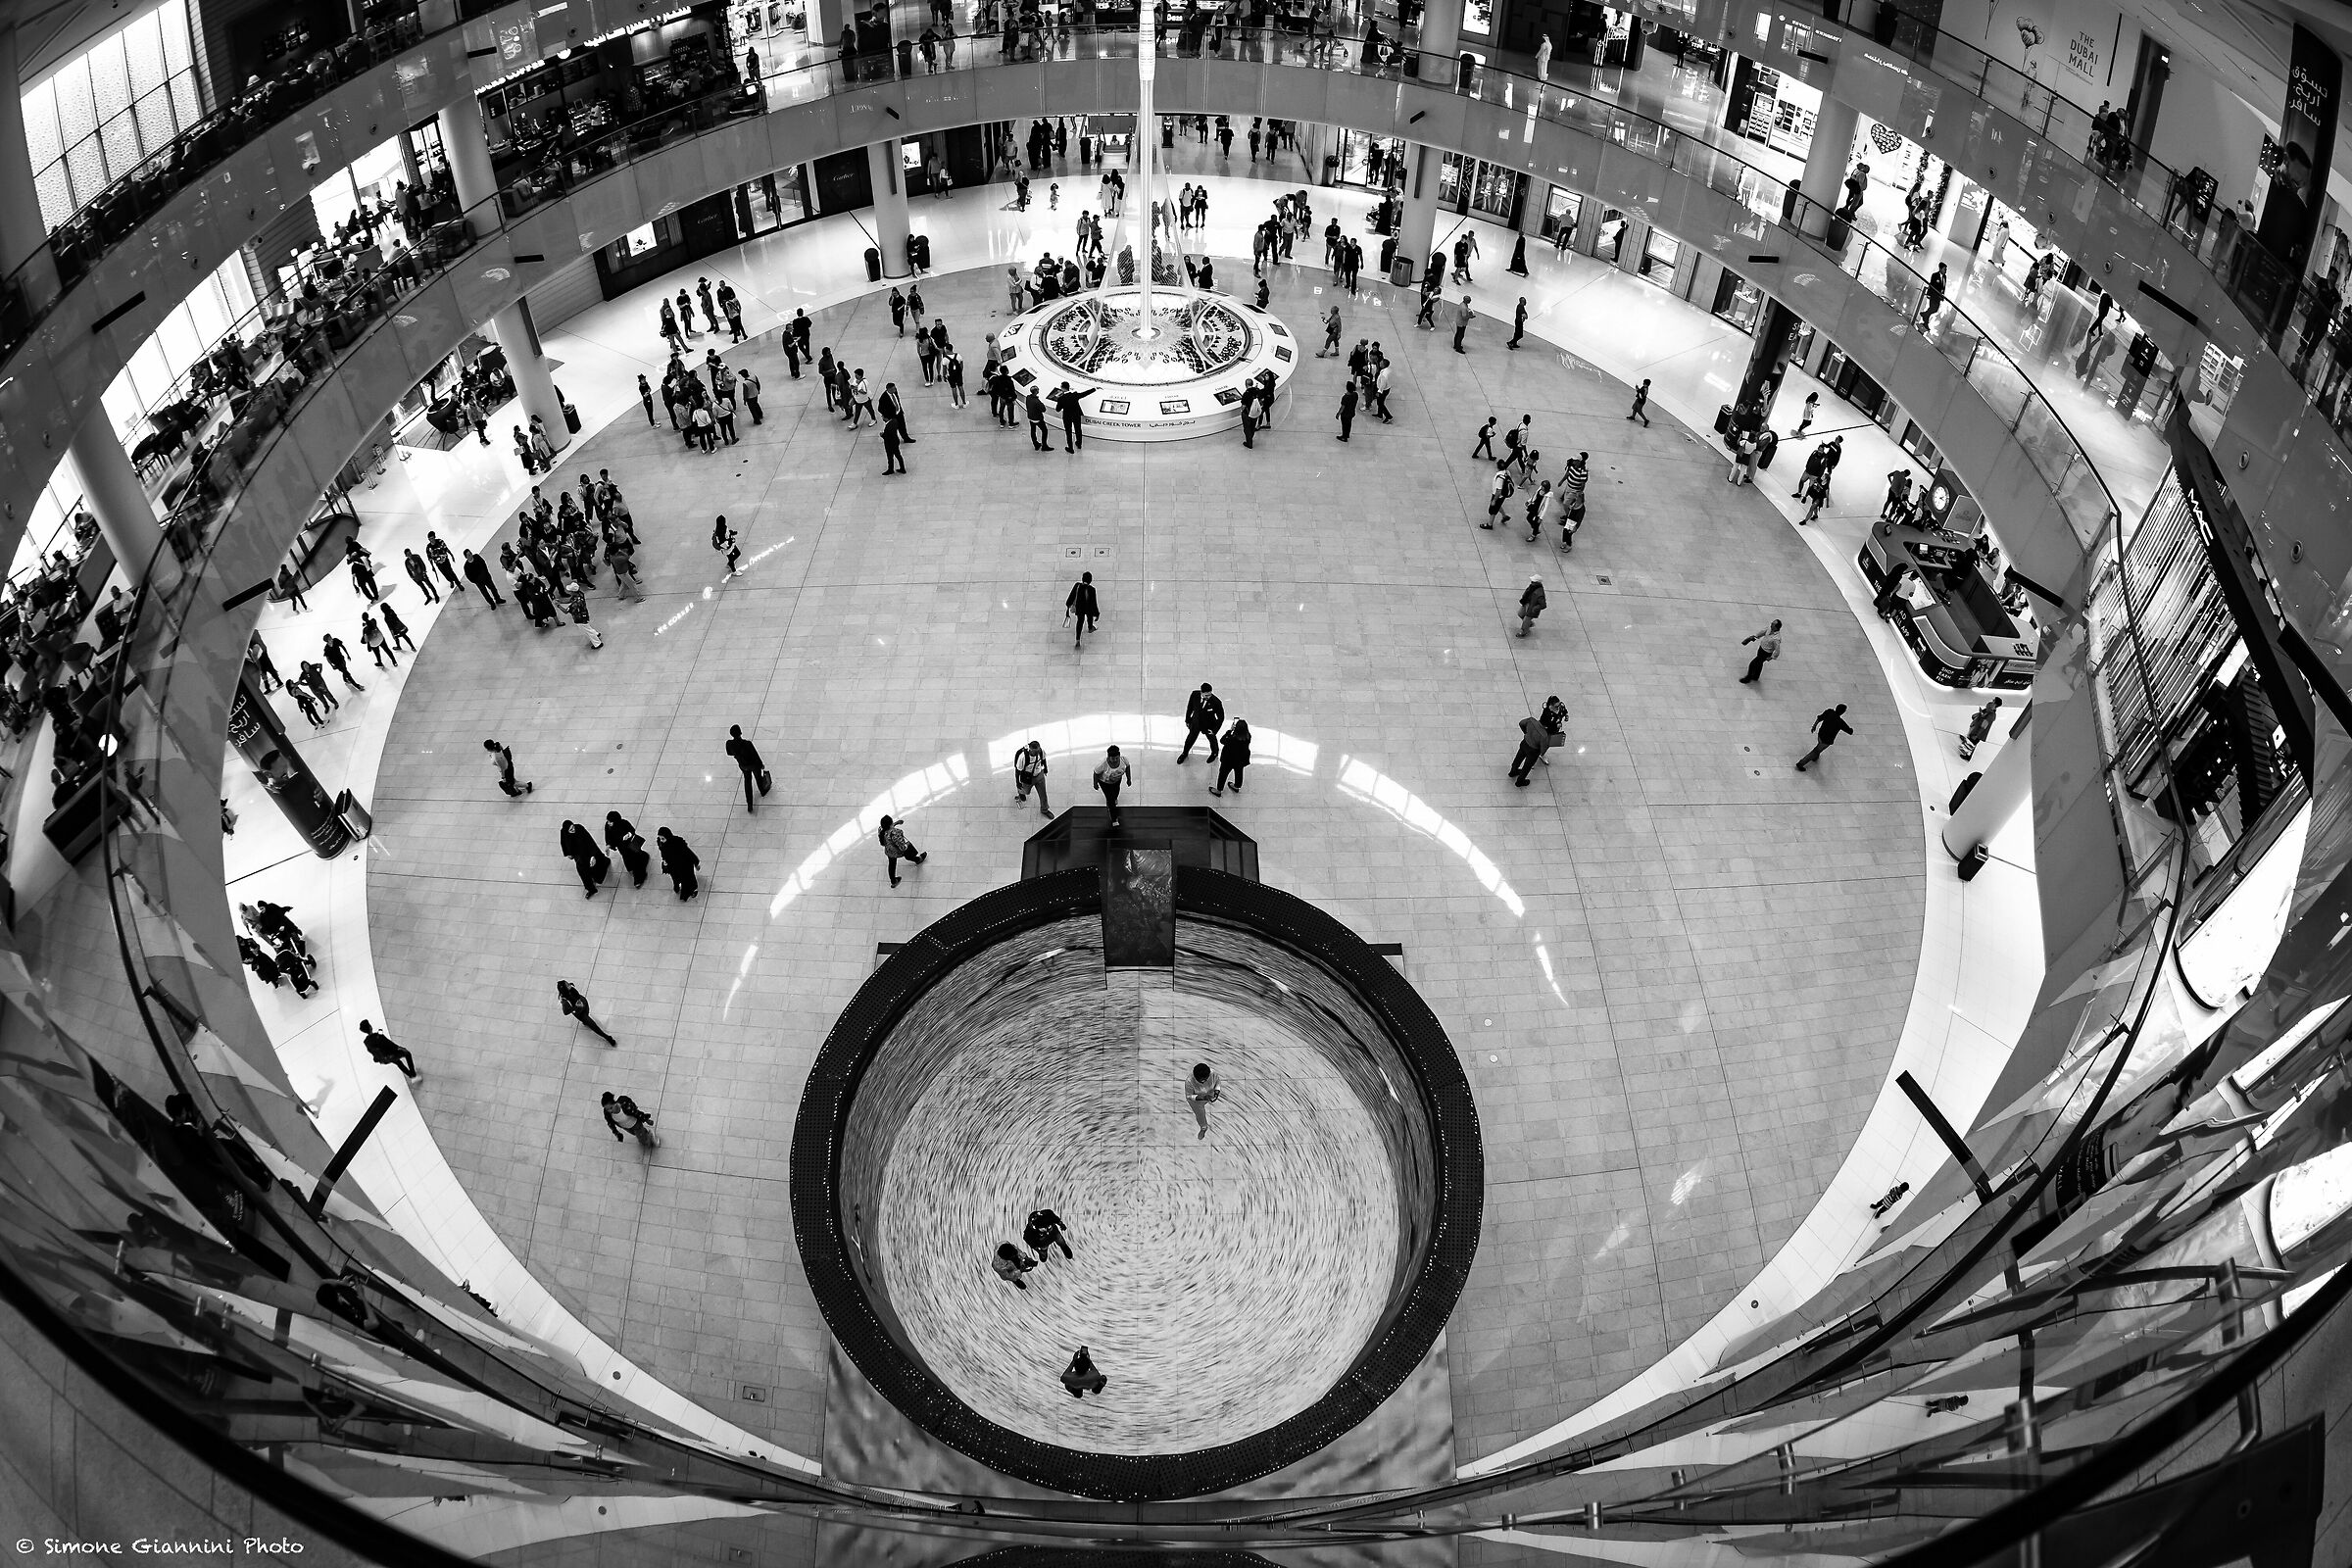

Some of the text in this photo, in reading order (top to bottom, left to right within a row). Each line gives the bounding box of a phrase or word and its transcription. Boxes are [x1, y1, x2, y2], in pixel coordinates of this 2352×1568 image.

[2070, 38, 2099, 65] DUBAI
[2079, 30, 2095, 48] THE
[2068, 53, 2094, 78] MALL
